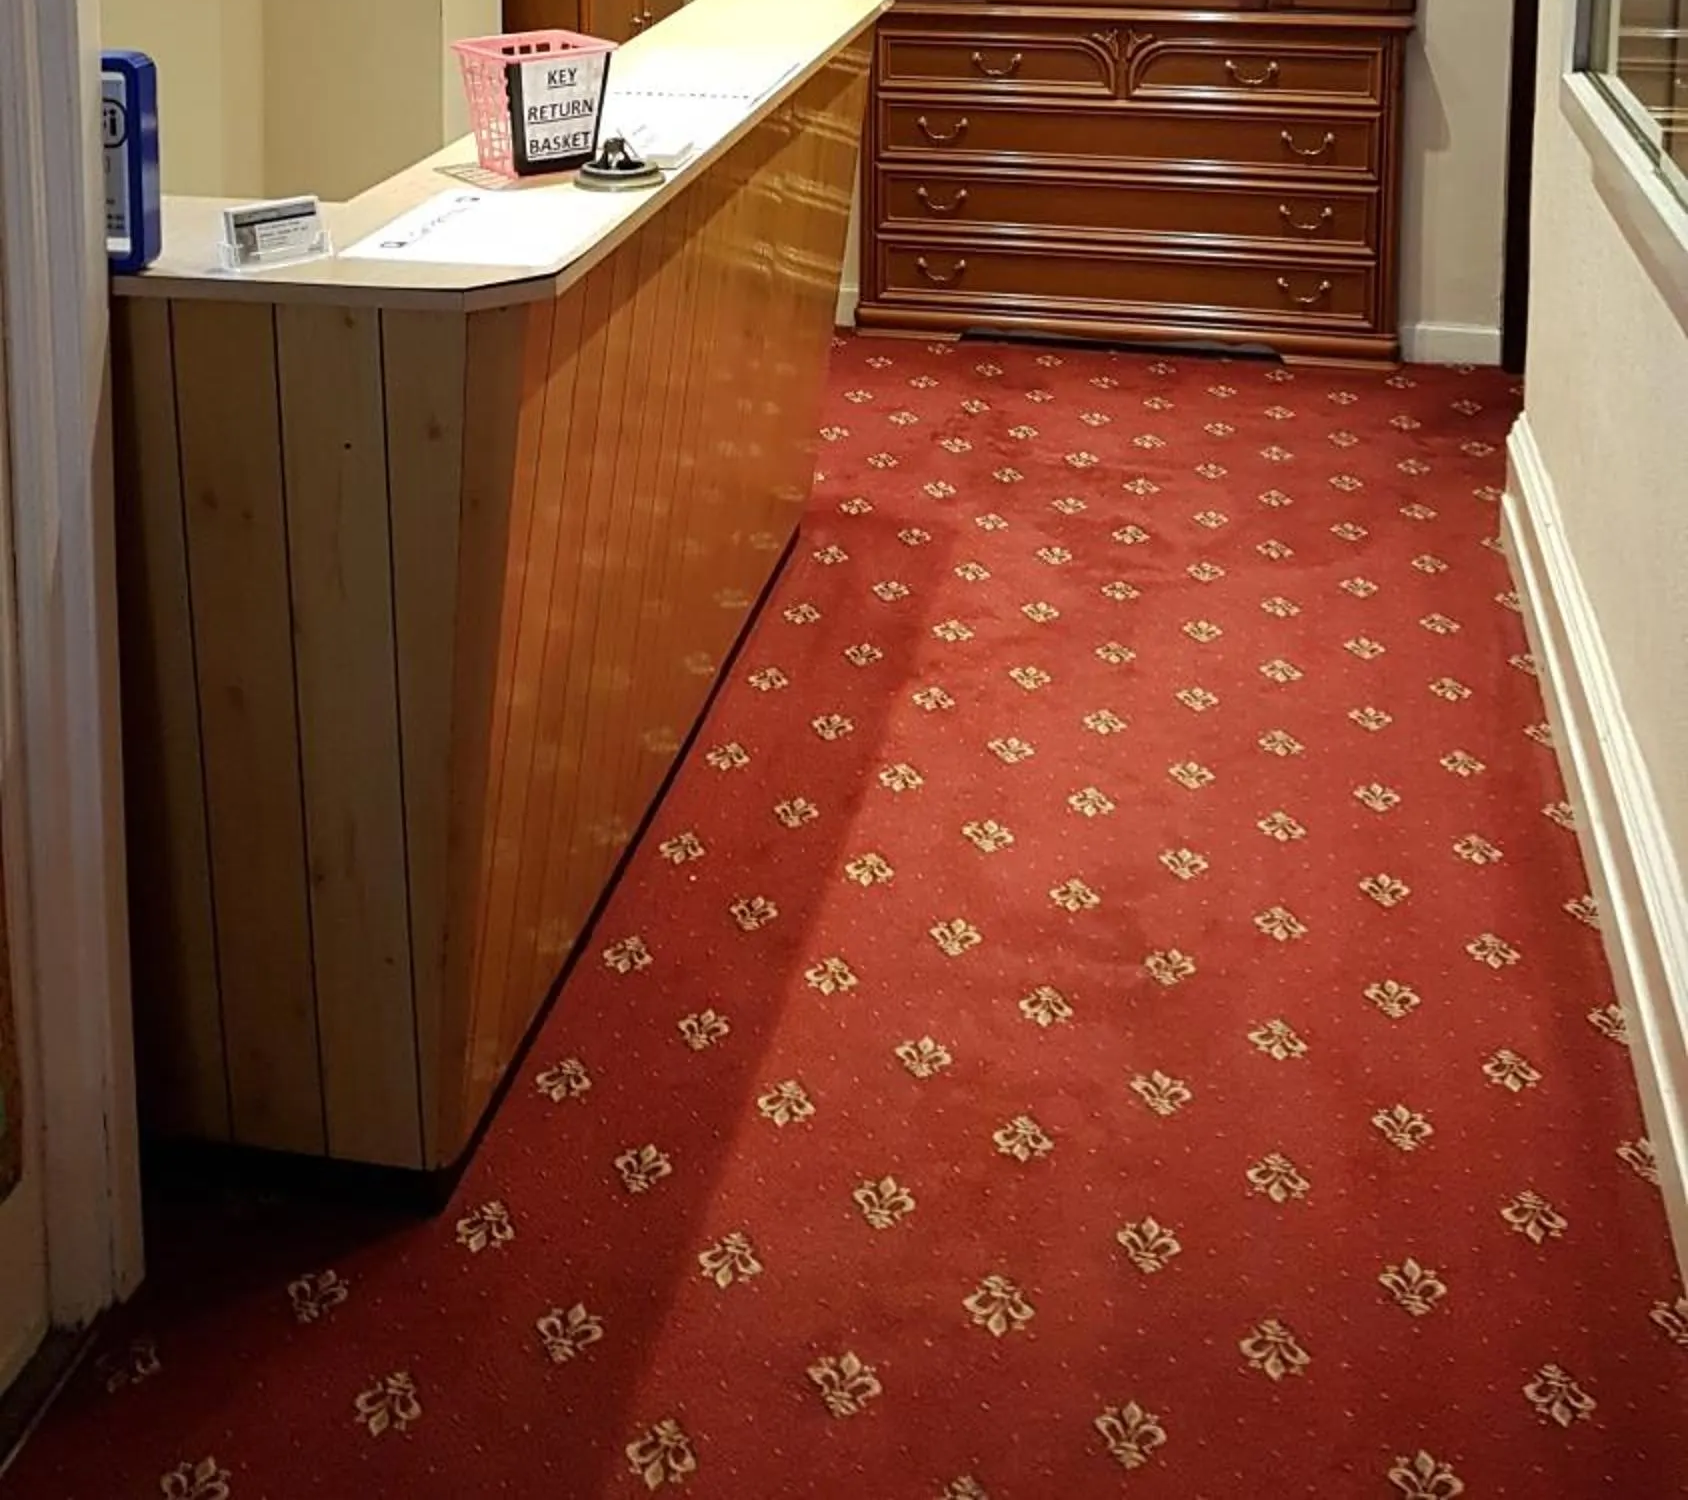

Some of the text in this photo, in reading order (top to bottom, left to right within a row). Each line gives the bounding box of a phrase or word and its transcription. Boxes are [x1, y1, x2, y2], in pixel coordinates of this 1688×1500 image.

[548, 67, 577, 86] KEY
[527, 98, 594, 122] RETURN
[529, 130, 591, 156] BASKET
